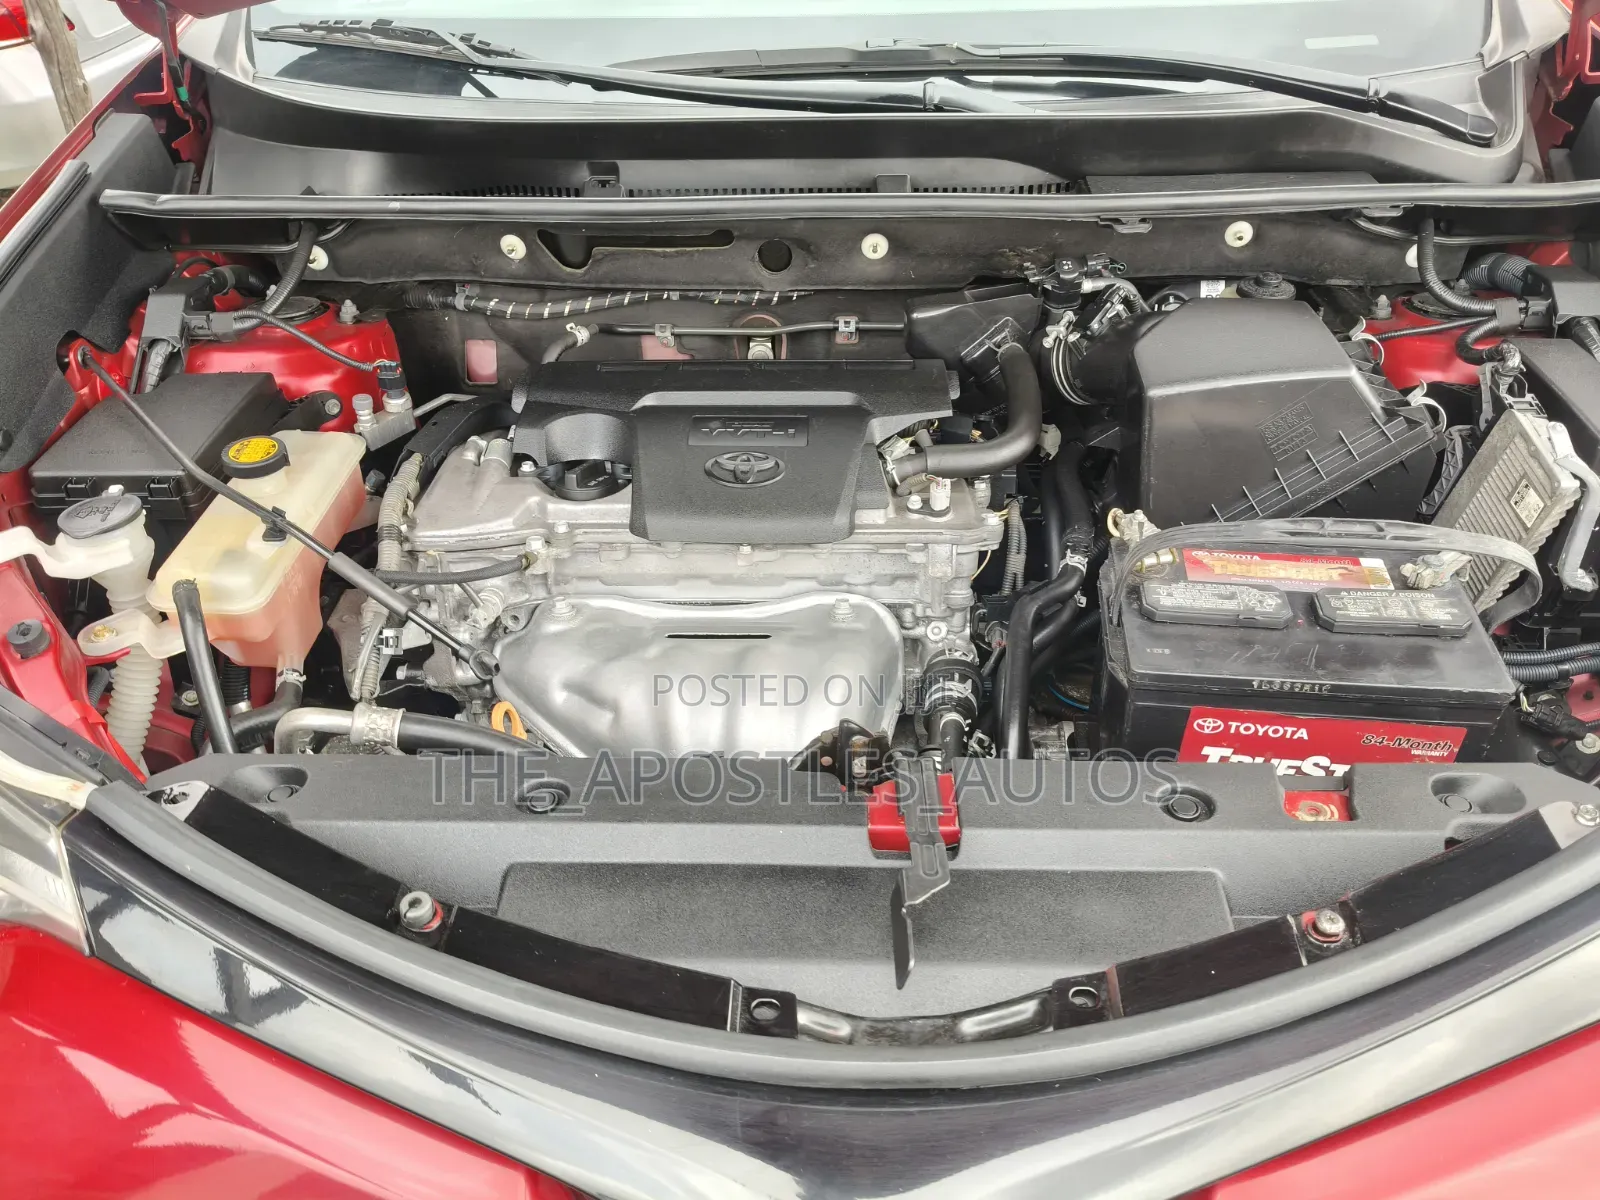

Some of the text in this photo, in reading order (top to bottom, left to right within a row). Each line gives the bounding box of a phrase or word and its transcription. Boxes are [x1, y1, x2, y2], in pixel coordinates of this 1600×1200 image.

[1349, 590, 1389, 598] DANGER
[1227, 721, 1309, 740] TOYOTA
[1361, 733, 1453, 752] 84-Month
[1410, 748, 1450, 757] WARRANTY
